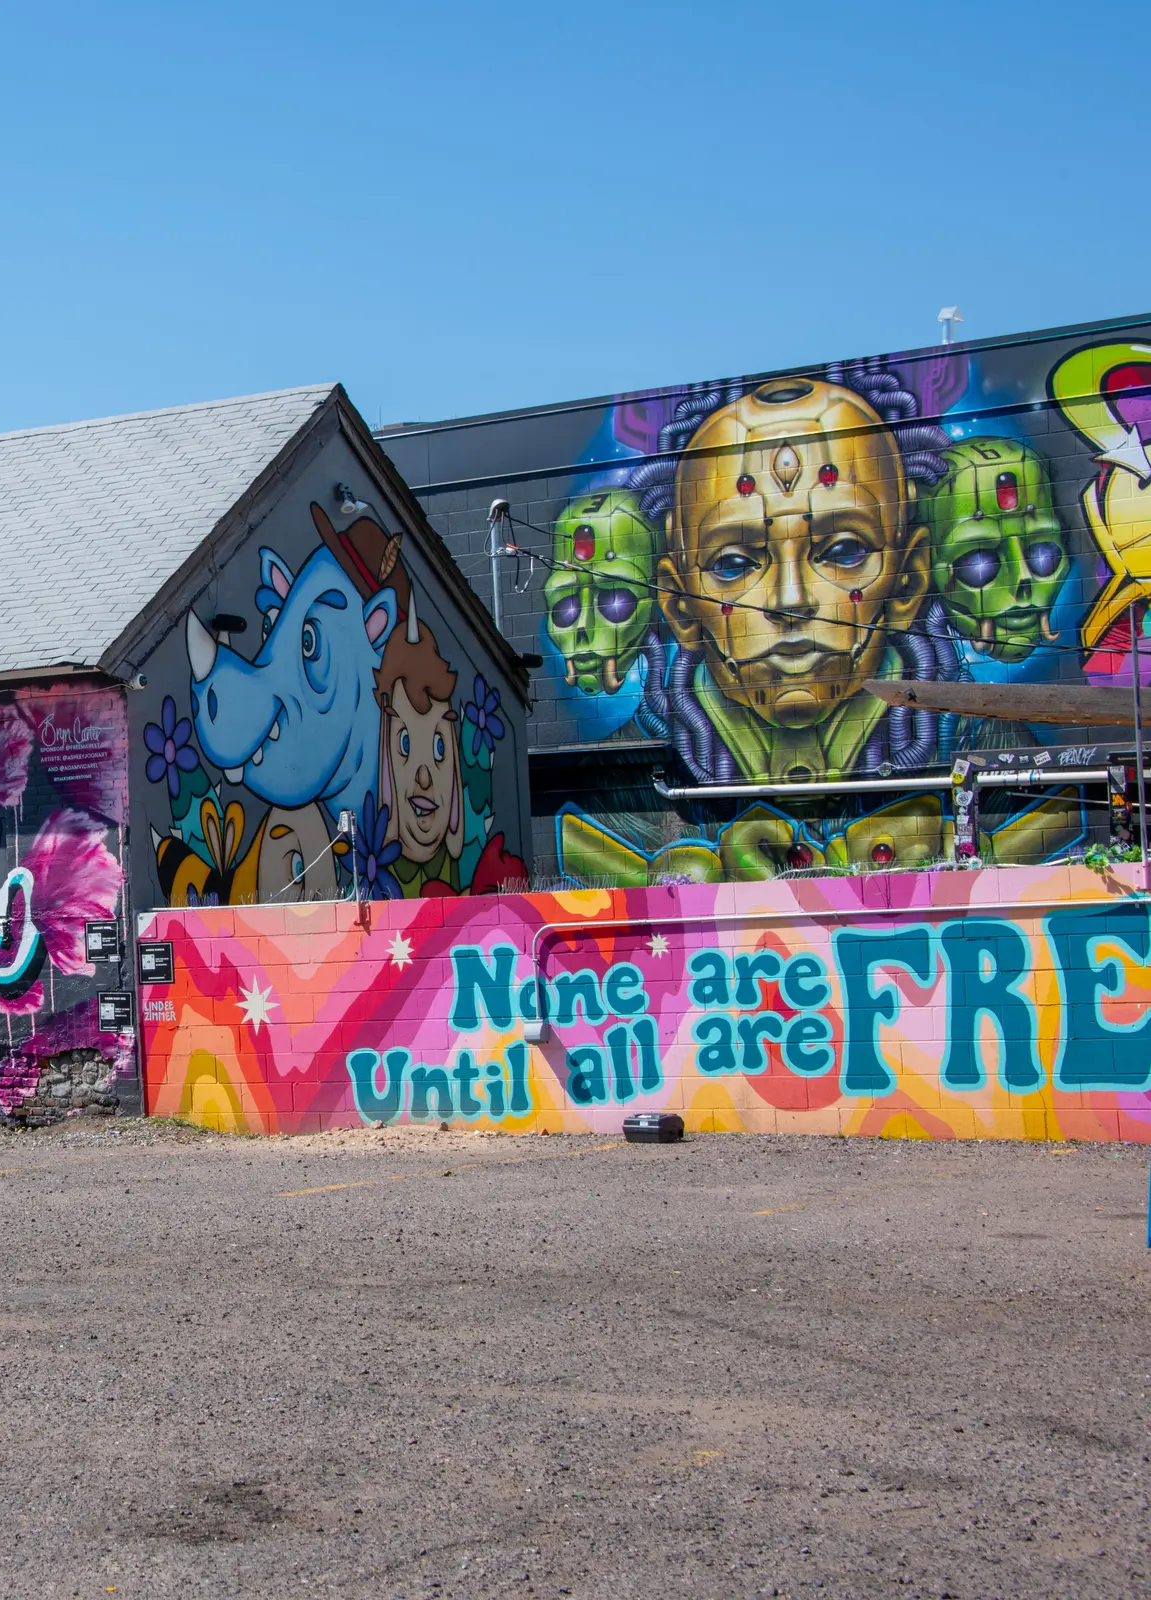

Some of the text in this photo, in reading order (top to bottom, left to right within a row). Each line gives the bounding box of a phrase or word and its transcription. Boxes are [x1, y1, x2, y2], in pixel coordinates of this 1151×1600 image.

[143, 1000, 174, 1011] LINDEE
[449, 944, 649, 1033] None
[687, 948, 832, 1010] are
[144, 1011, 177, 1022] ZIMMER
[346, 1009, 835, 1126] Until all are
